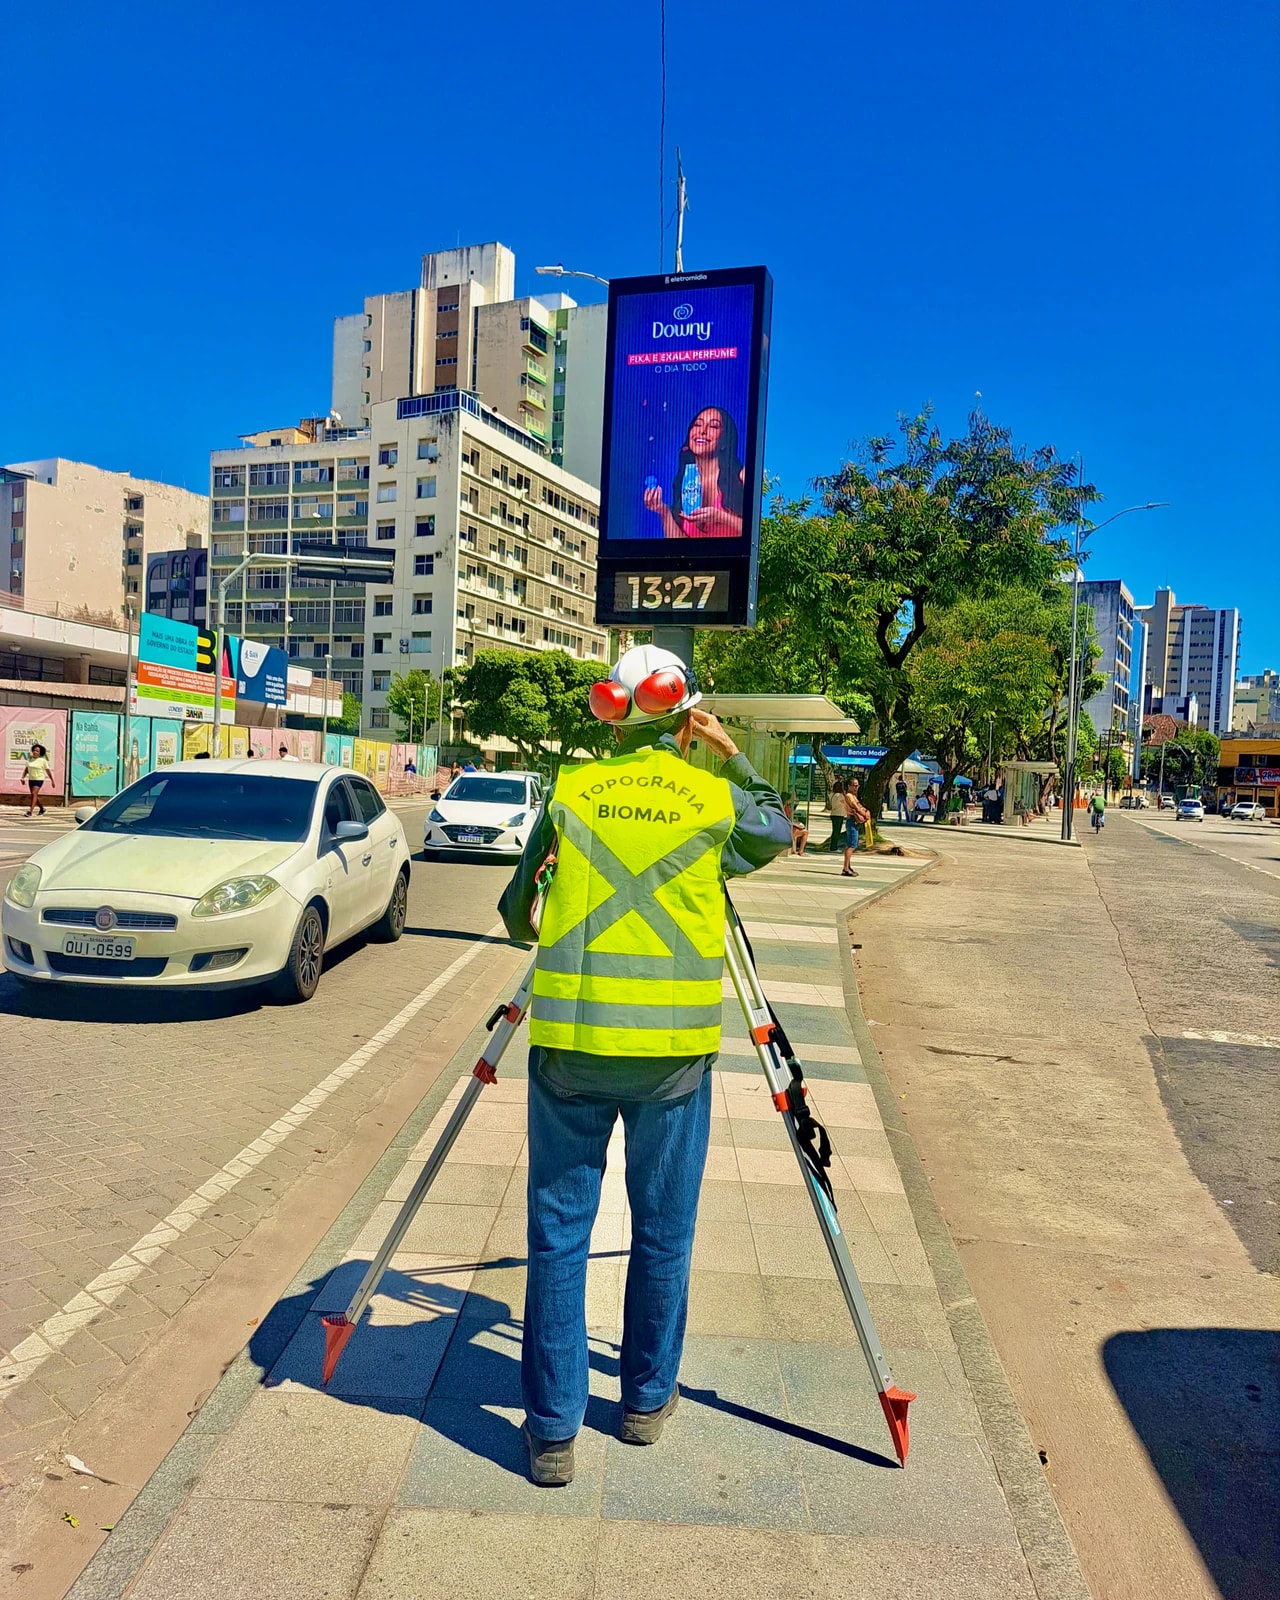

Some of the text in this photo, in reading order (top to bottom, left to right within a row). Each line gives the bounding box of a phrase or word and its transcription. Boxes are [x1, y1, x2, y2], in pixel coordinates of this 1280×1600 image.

[670, 274, 708, 283] eletromidia
[652, 321, 711, 341] Downy
[629, 348, 735, 364] FIXA E EXALA PERFUME
[654, 362, 708, 374] O DIA TODO
[627, 575, 716, 609] 13:27
[577, 775, 705, 815] TOPOGRAFIA
[597, 804, 682, 825] BIOMAP
